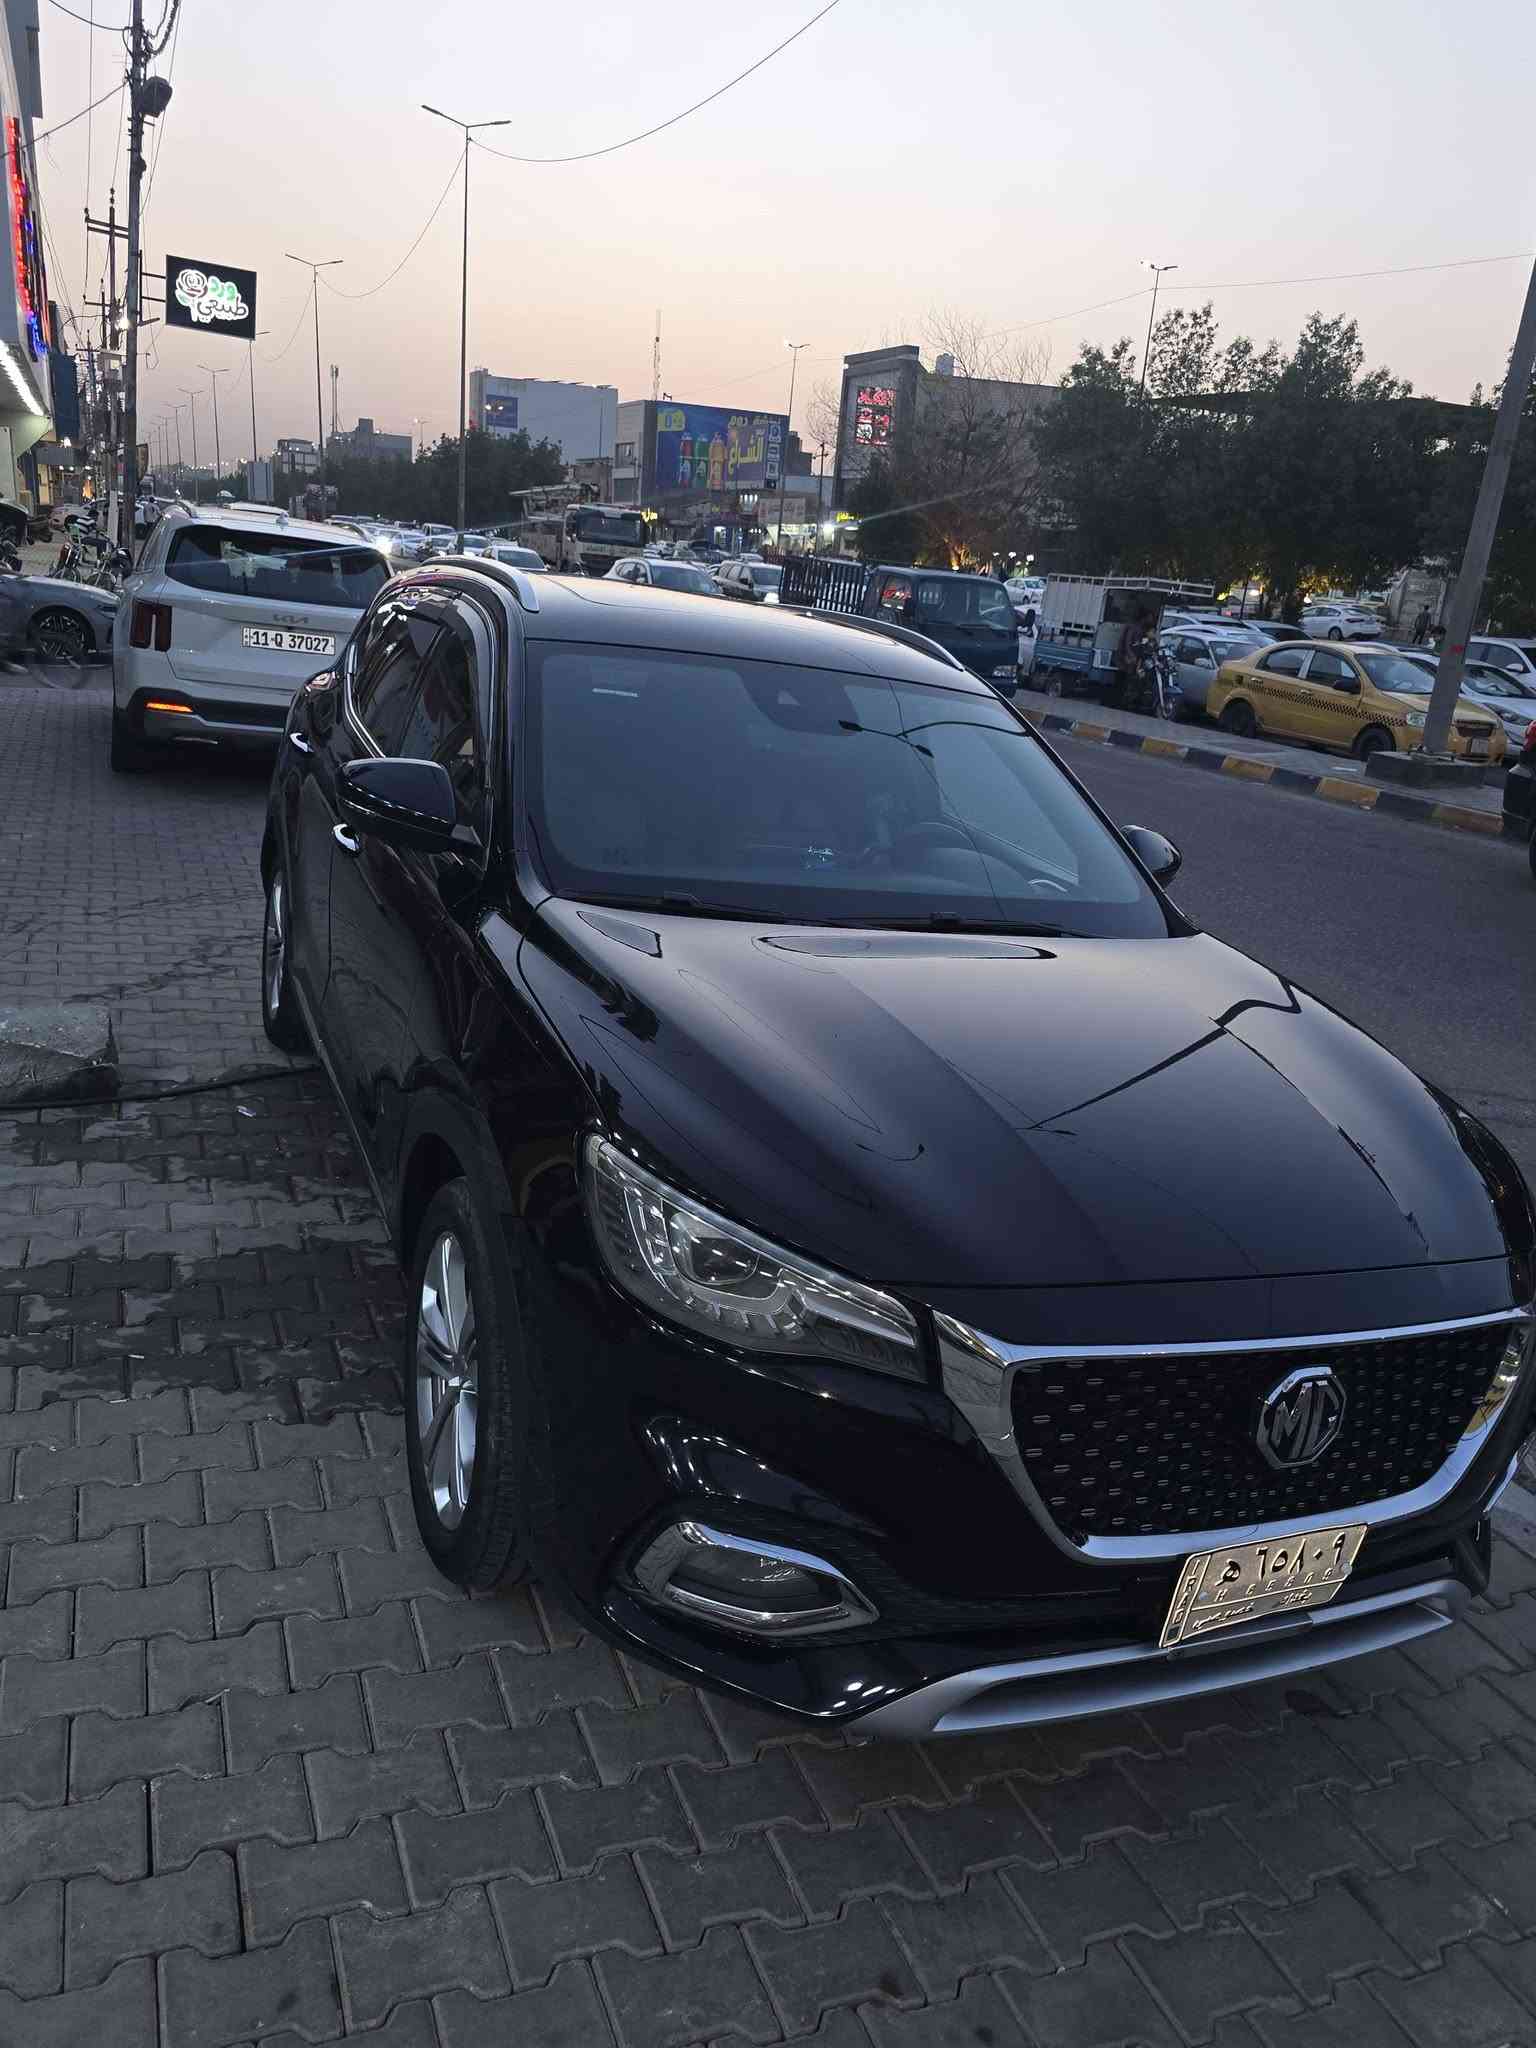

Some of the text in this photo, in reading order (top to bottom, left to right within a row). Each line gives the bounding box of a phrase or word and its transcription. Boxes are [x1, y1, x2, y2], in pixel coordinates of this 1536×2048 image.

[197, 295, 247, 321] طبيعي
[288, 634, 330, 652] 37027
[1268, 1378, 1341, 1461] MG
